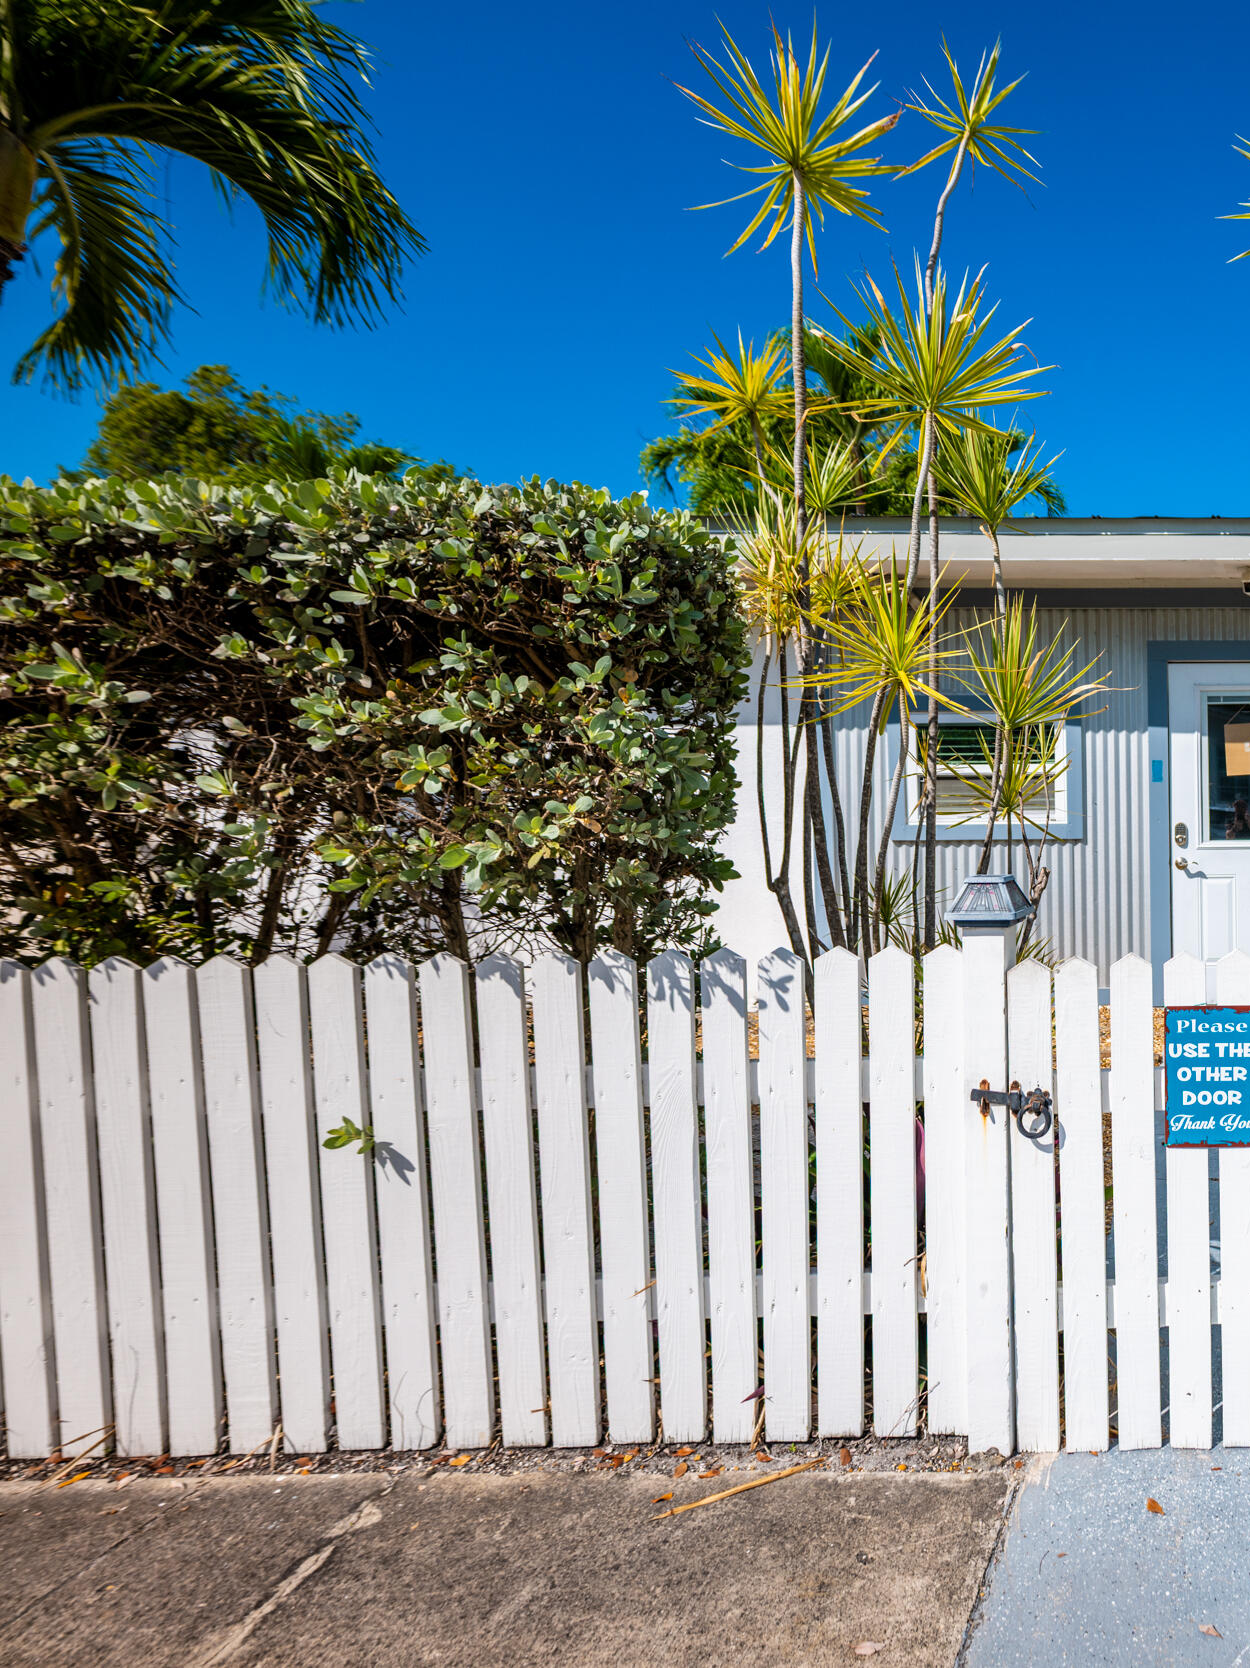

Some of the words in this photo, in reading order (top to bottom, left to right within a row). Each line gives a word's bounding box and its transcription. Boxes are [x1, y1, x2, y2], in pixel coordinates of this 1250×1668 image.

[1176, 1018, 1248, 1033] Please
[1168, 1043, 1210, 1058] USE
[1176, 1066, 1247, 1082] OTHER
[1182, 1090, 1242, 1106] DOOR
[1170, 1114, 1216, 1131] Thank
